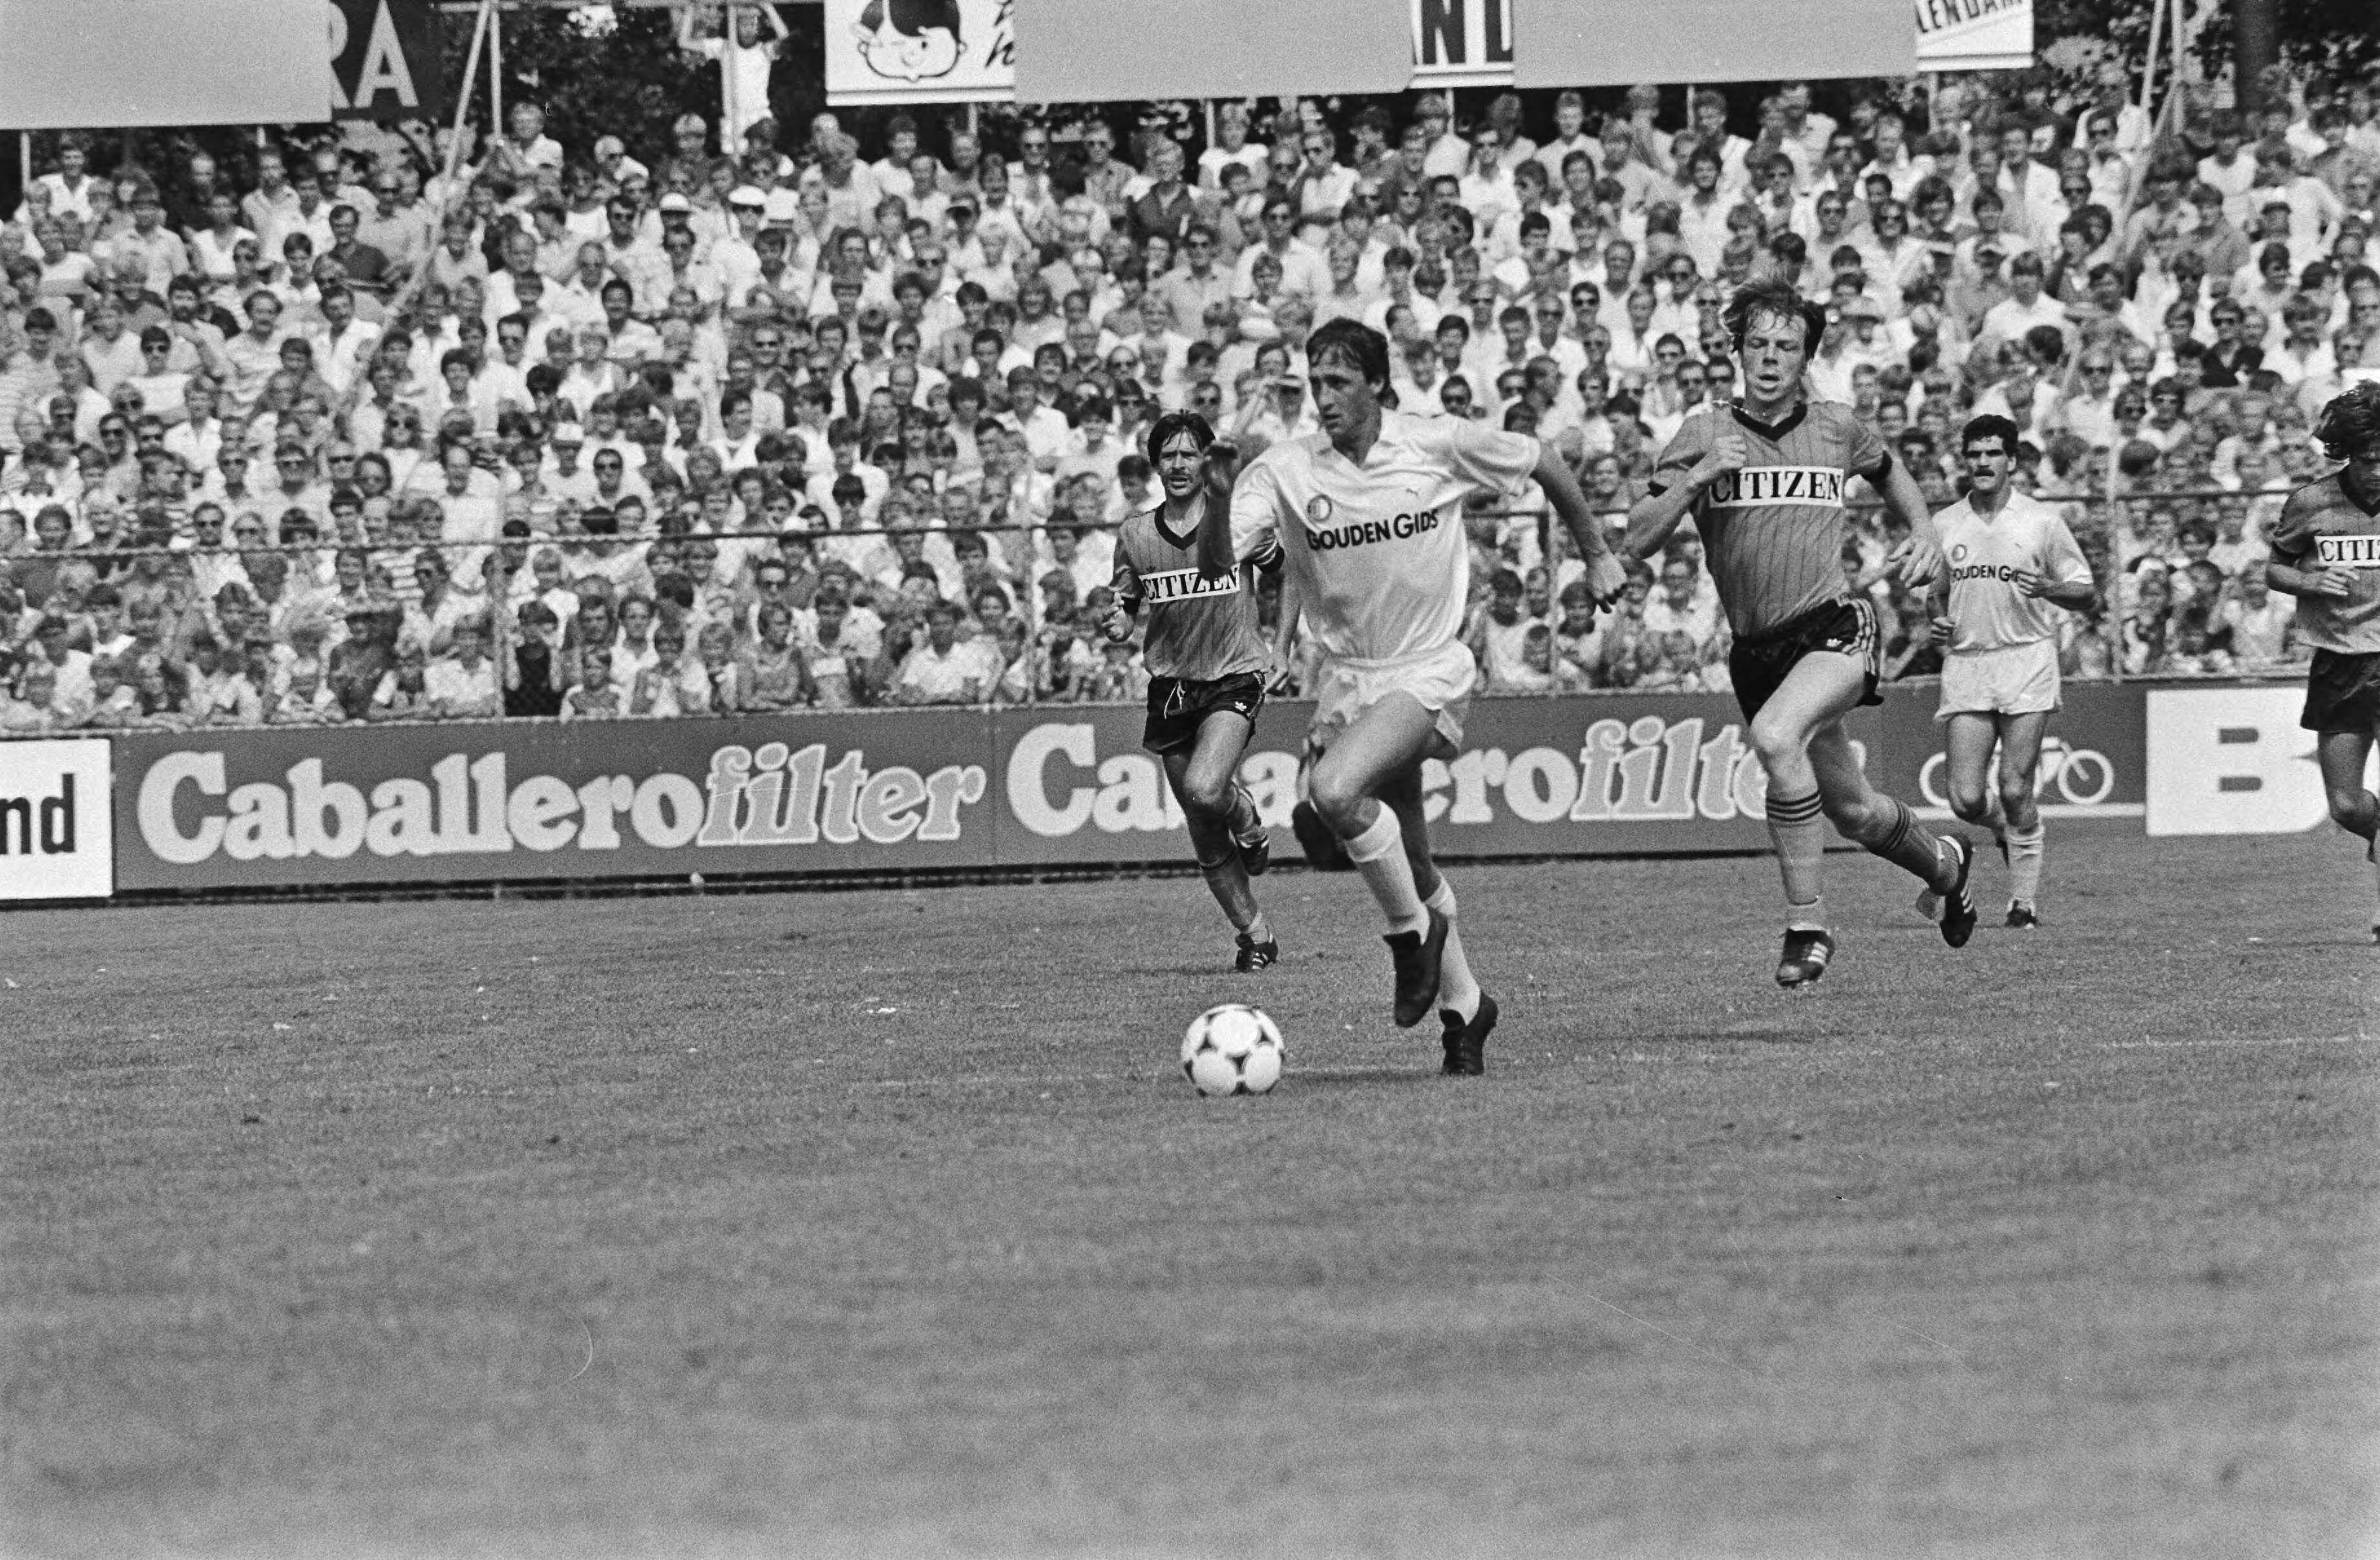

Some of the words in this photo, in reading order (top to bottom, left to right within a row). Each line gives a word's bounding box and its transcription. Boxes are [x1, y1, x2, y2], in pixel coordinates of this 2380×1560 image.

[1712, 468, 1841, 503] CITIZEN
[1305, 519, 1391, 551] GOUDEN
[1393, 508, 1438, 539] GIDS
[2319, 539, 2380, 562] CITI
[1142, 565, 1241, 601] CITIZEN
[1952, 564, 1996, 582] OUDEN
[0, 773, 75, 854] nd
